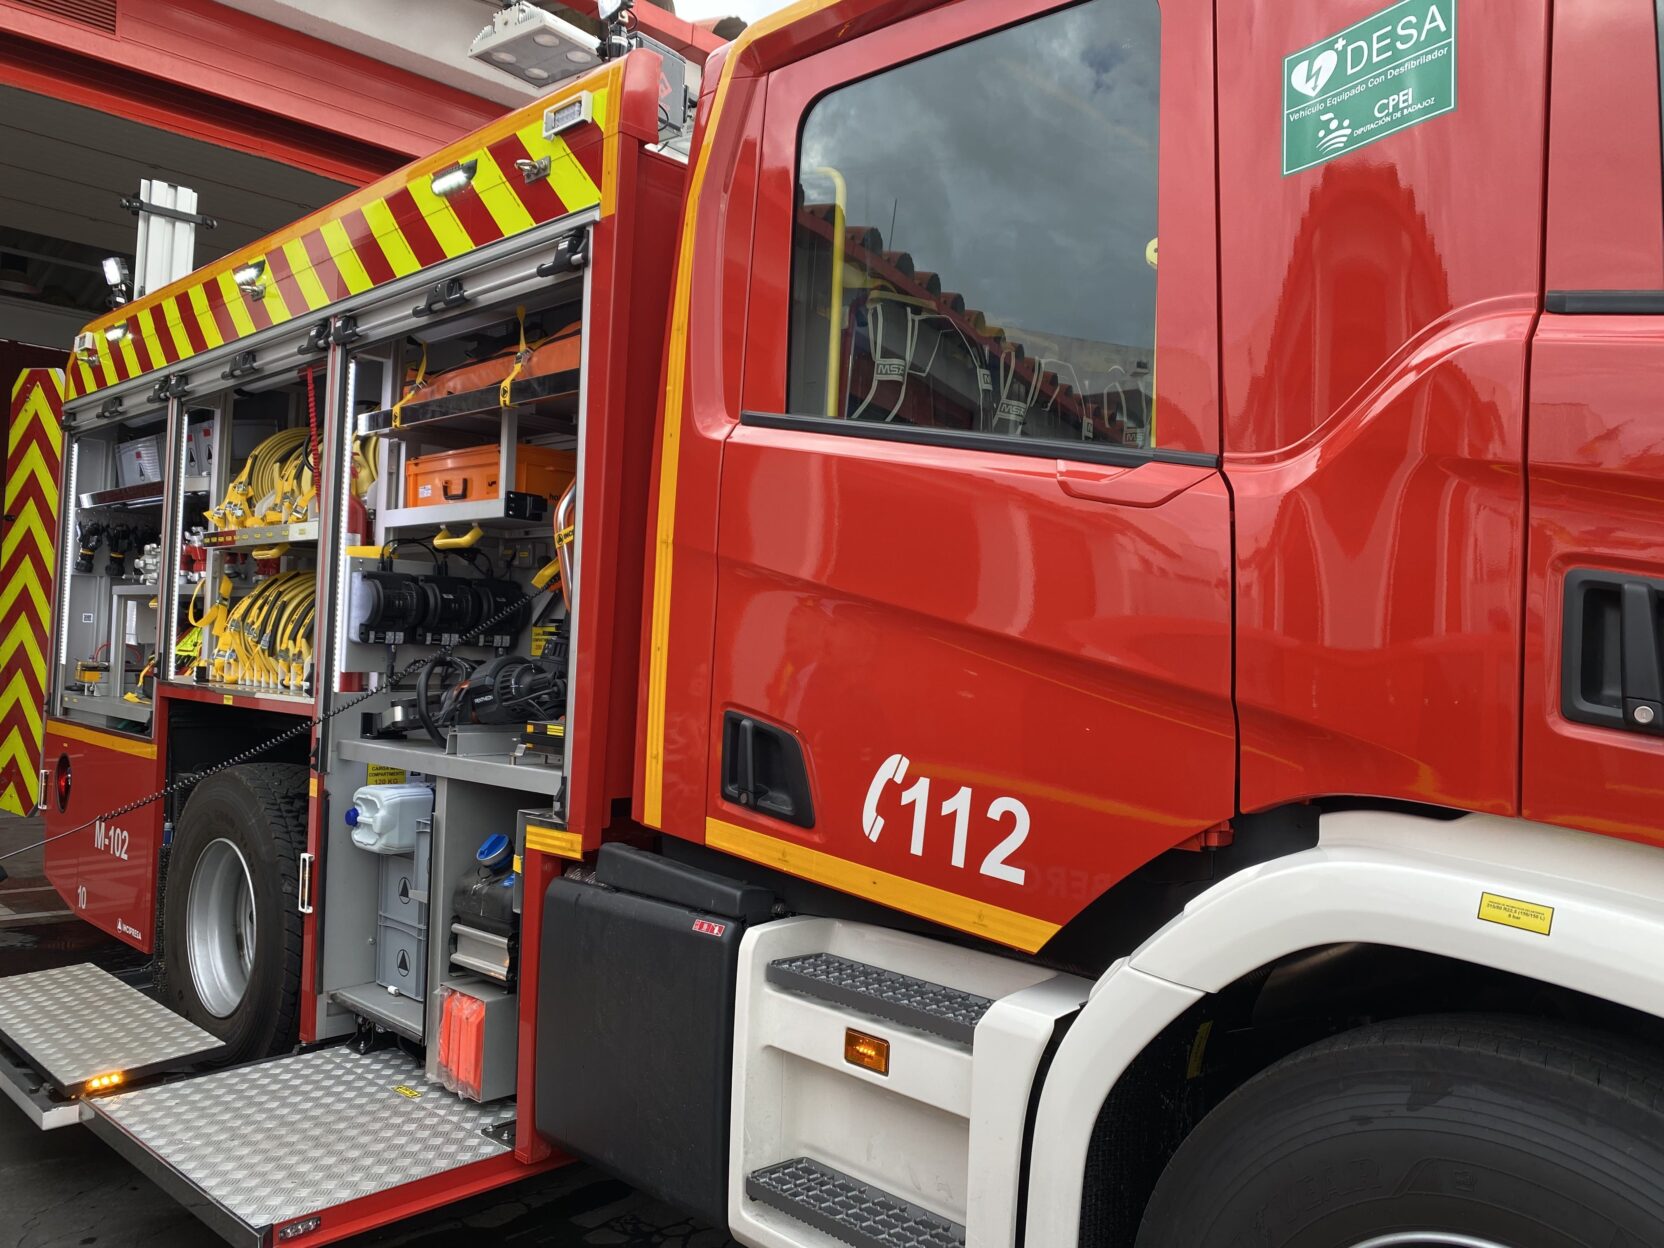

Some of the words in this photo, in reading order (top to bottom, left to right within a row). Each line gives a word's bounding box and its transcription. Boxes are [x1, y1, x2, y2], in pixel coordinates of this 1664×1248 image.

[1346, 4, 1447, 76] DESA
[1326, 84, 1366, 107] Equipado
[1367, 75, 1385, 88] Con
[1387, 47, 1448, 79] Desfibrilador
[1353, 115, 1392, 136] DIPUTACIÓN
[1392, 110, 1402, 120] DE
[1403, 97, 1435, 116] BADAJOZ
[1374, 88, 1413, 118] CPEI
[94, 820, 129, 860] M-102
[900, 776, 1031, 886] 112
[77, 885, 87, 909] 10
